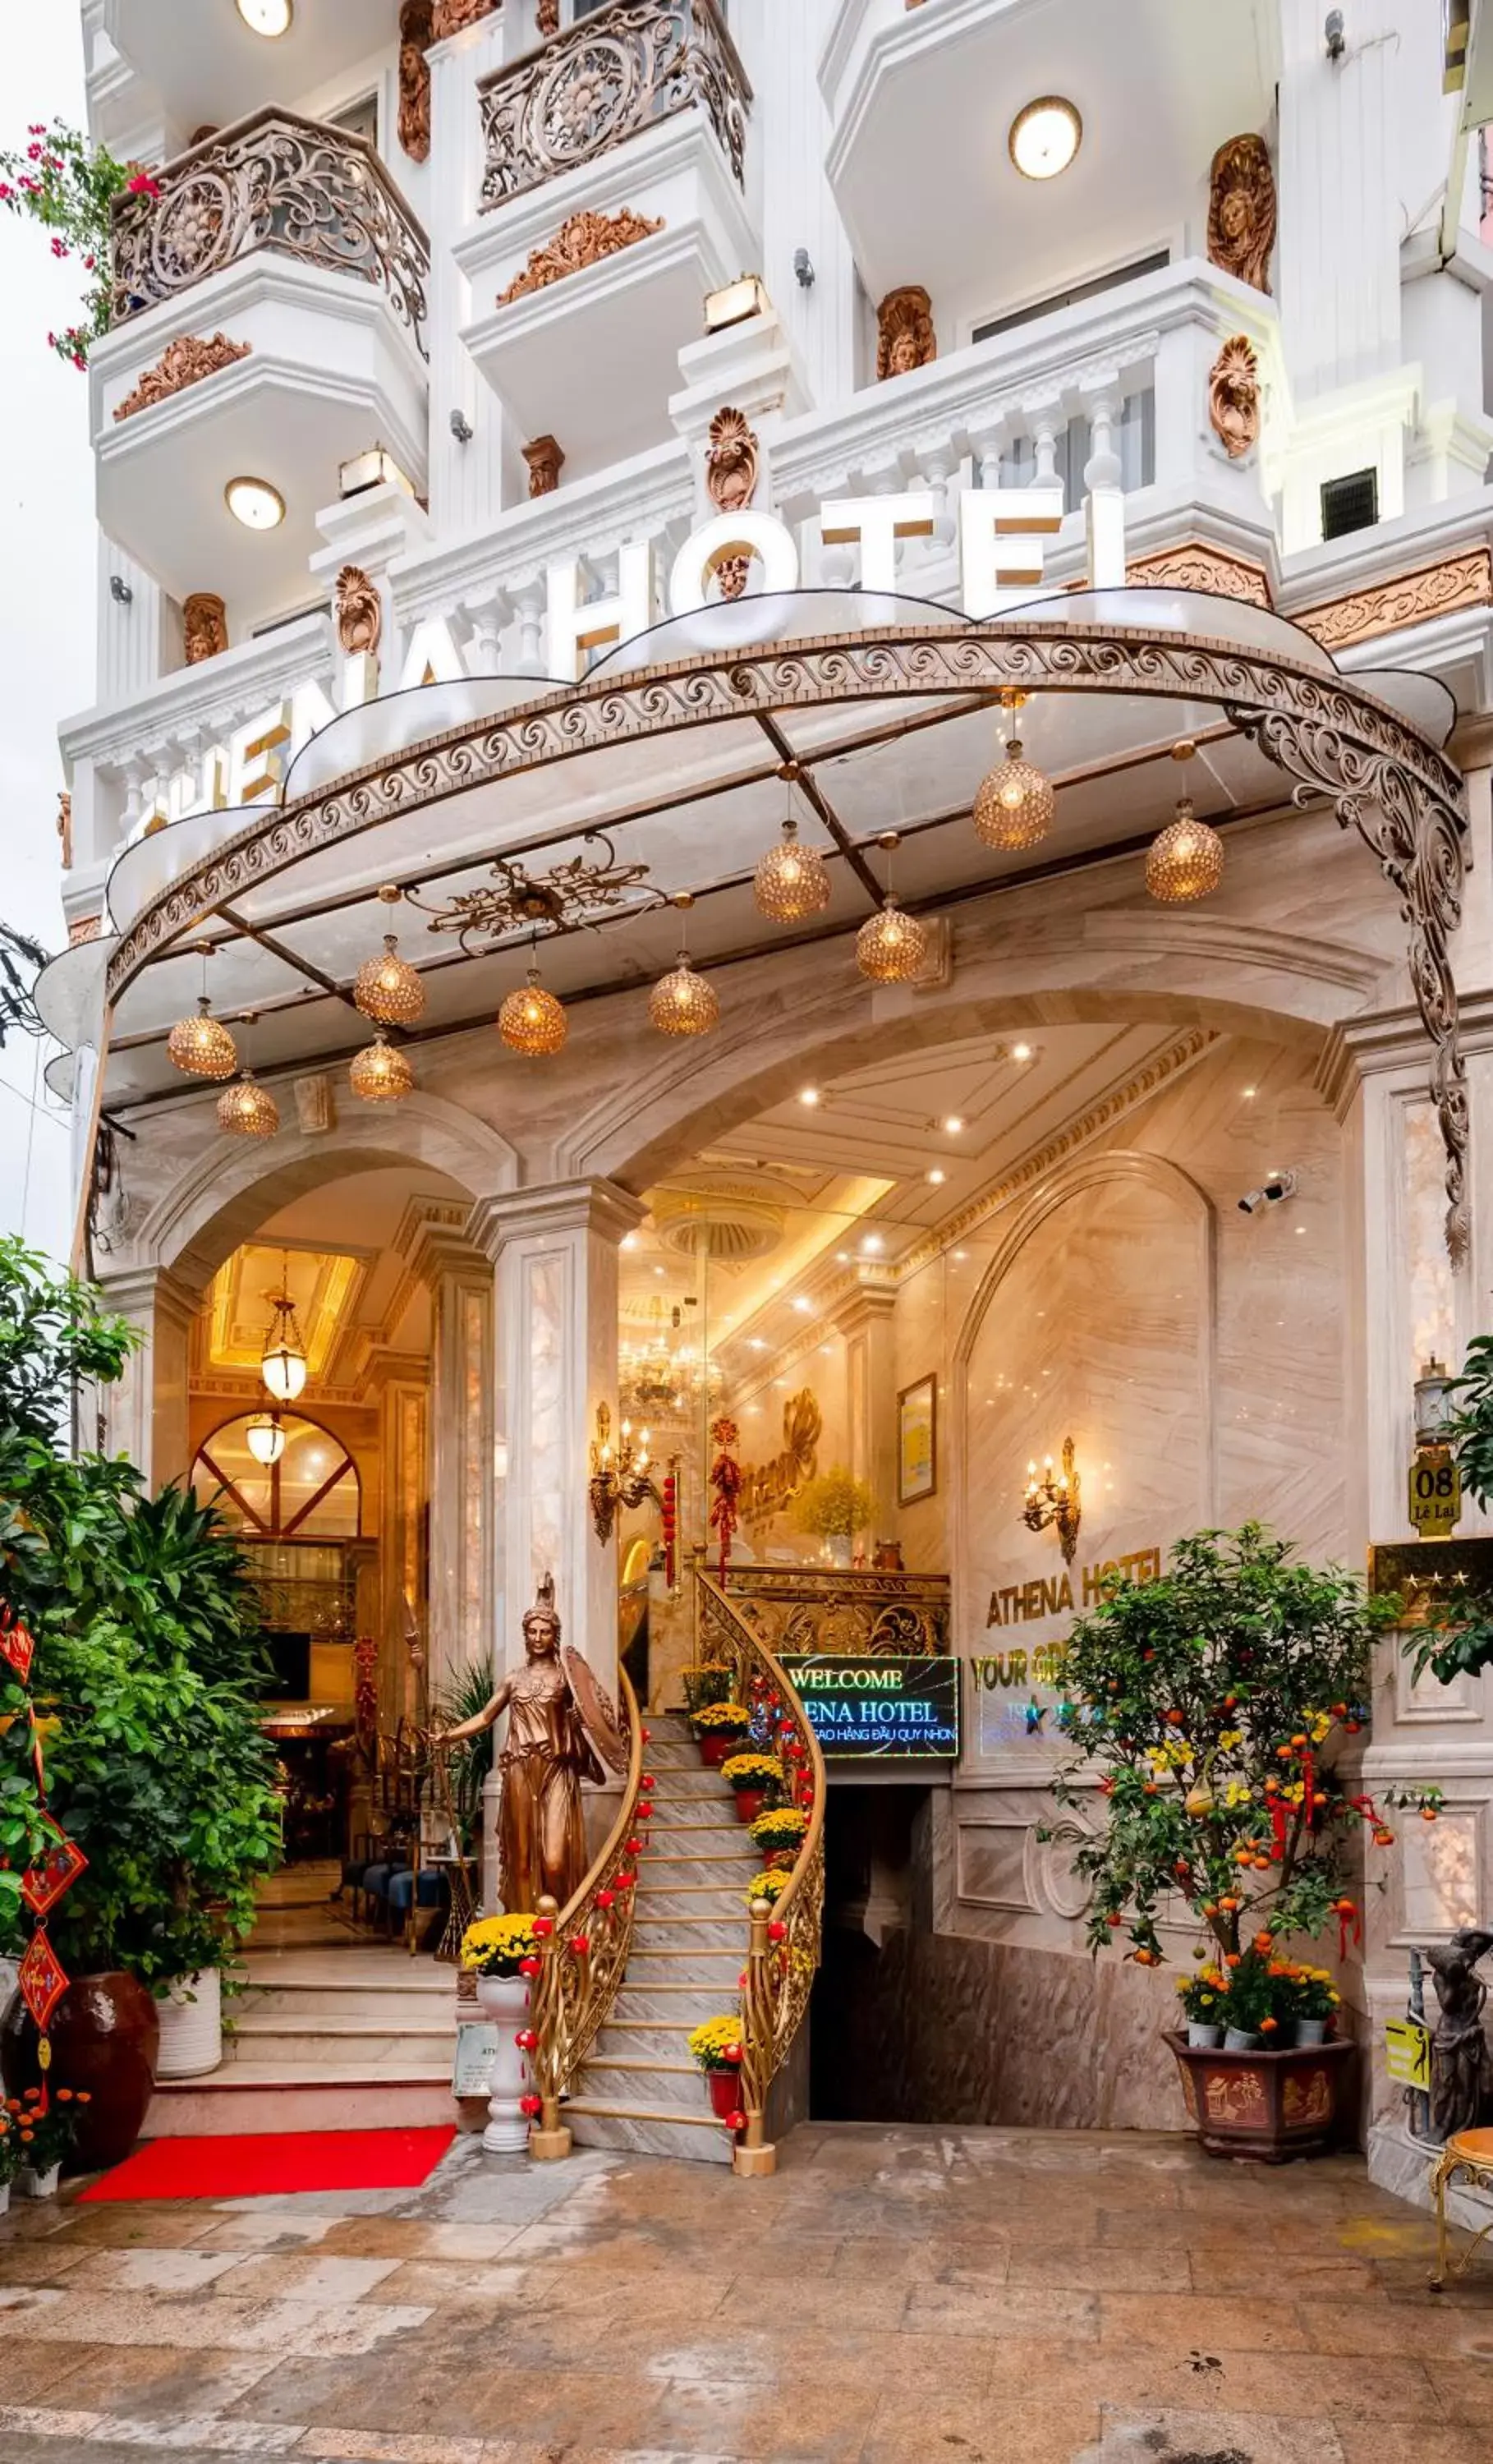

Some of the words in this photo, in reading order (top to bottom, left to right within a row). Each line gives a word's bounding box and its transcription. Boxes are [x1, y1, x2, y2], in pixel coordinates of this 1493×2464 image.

[545, 488, 1187, 687] HOTEL
[1416, 1467, 1453, 1499] 08
[1415, 1505, 1431, 1519] Lê
[986, 1572, 1075, 1629] ATHENA
[788, 1668, 903, 1689] WELCOME
[970, 1648, 1027, 1693] YOUR
[860, 1702, 938, 1722] HOTEL
[898, 1729, 922, 1742] QUY
